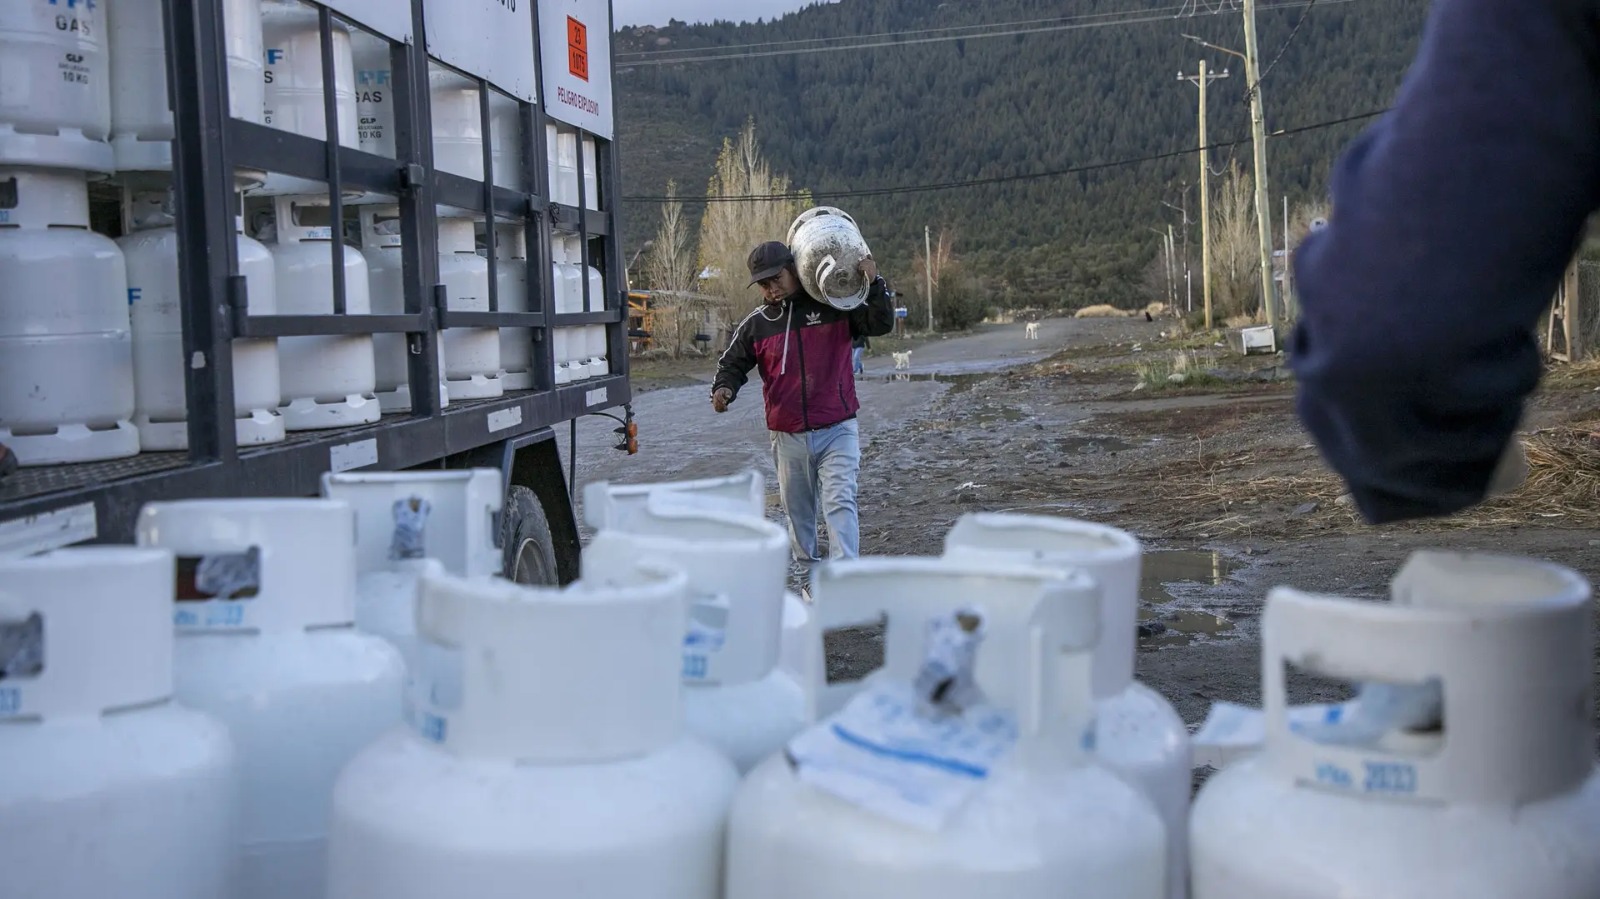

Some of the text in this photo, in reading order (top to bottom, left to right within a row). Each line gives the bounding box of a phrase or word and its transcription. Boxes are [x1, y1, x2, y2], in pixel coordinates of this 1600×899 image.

[55, 15, 90, 36] GAS
[574, 27, 581, 45] 23
[66, 53, 84, 63] GLP
[63, 71, 89, 85] 10 KG
[558, 86, 599, 116] PELIGRO EXPLOSIVO
[358, 131, 382, 139] 10 KG
